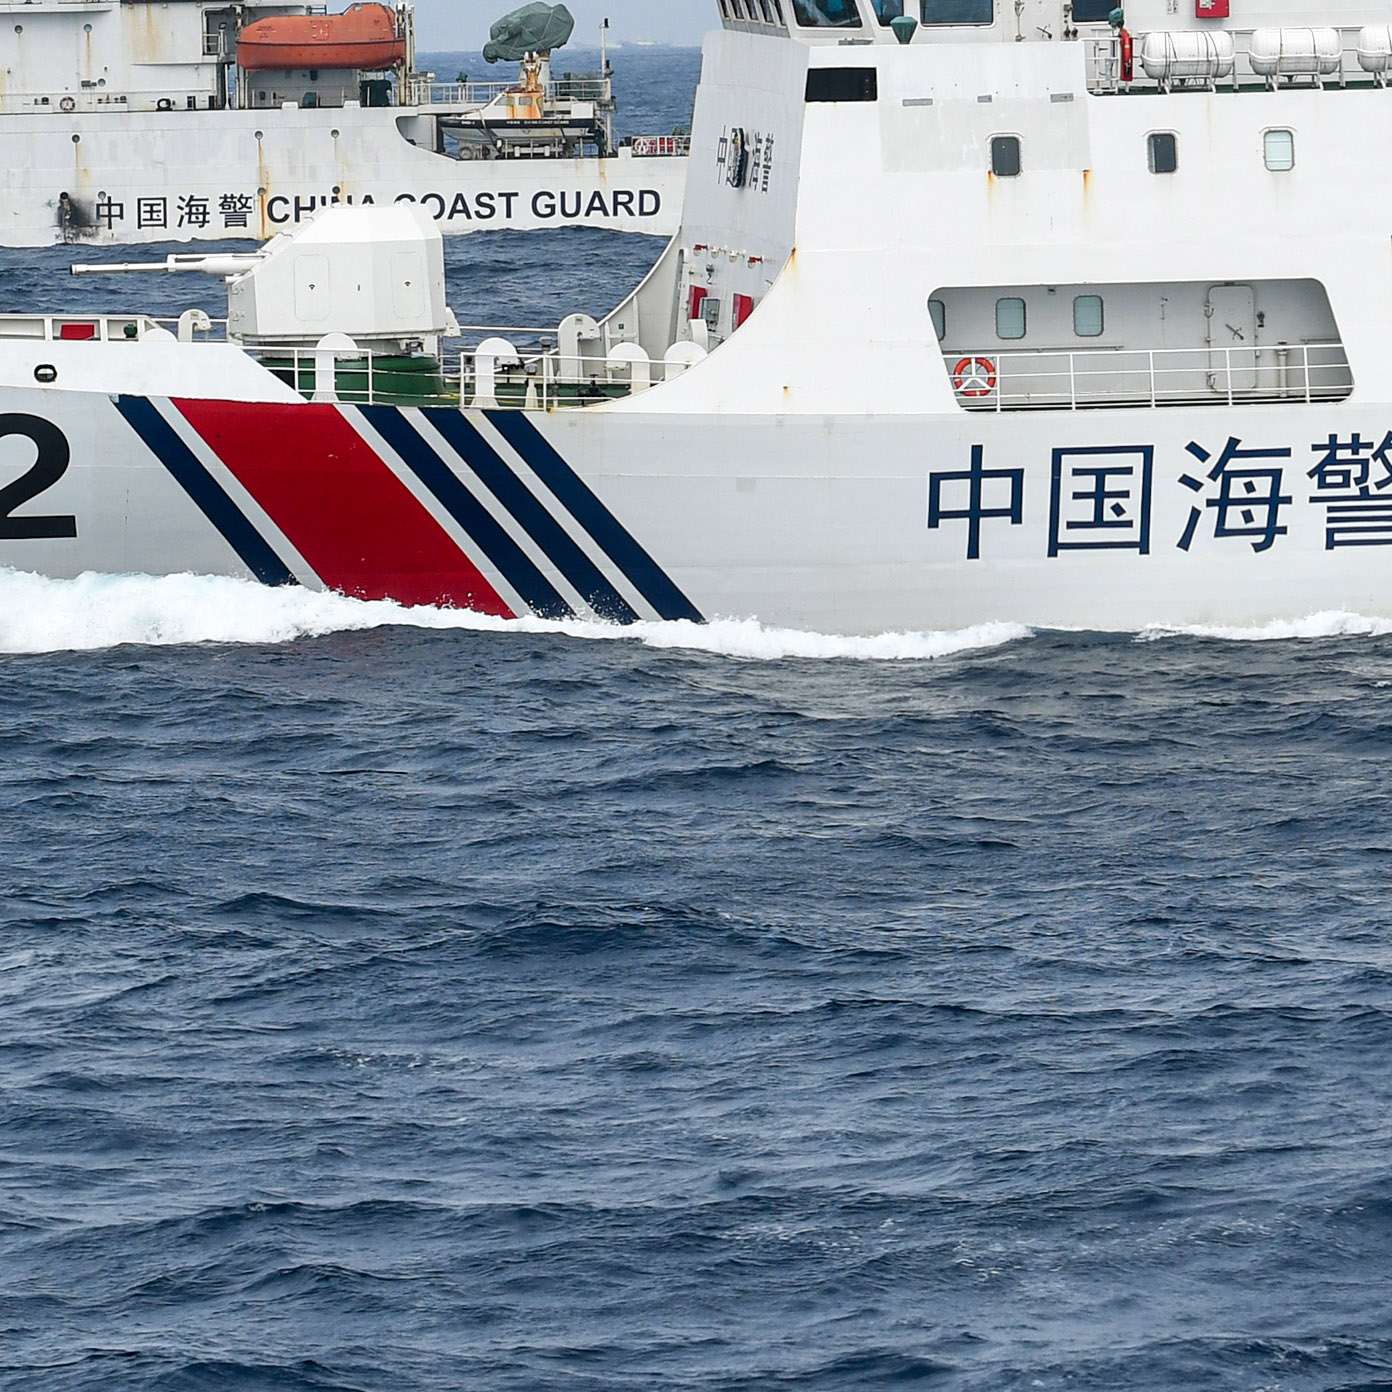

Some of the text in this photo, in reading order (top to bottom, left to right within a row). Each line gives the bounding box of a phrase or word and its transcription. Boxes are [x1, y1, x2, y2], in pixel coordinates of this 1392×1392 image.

[94, 192, 254, 231] 中国海警
[531, 189, 662, 219] GUARD
